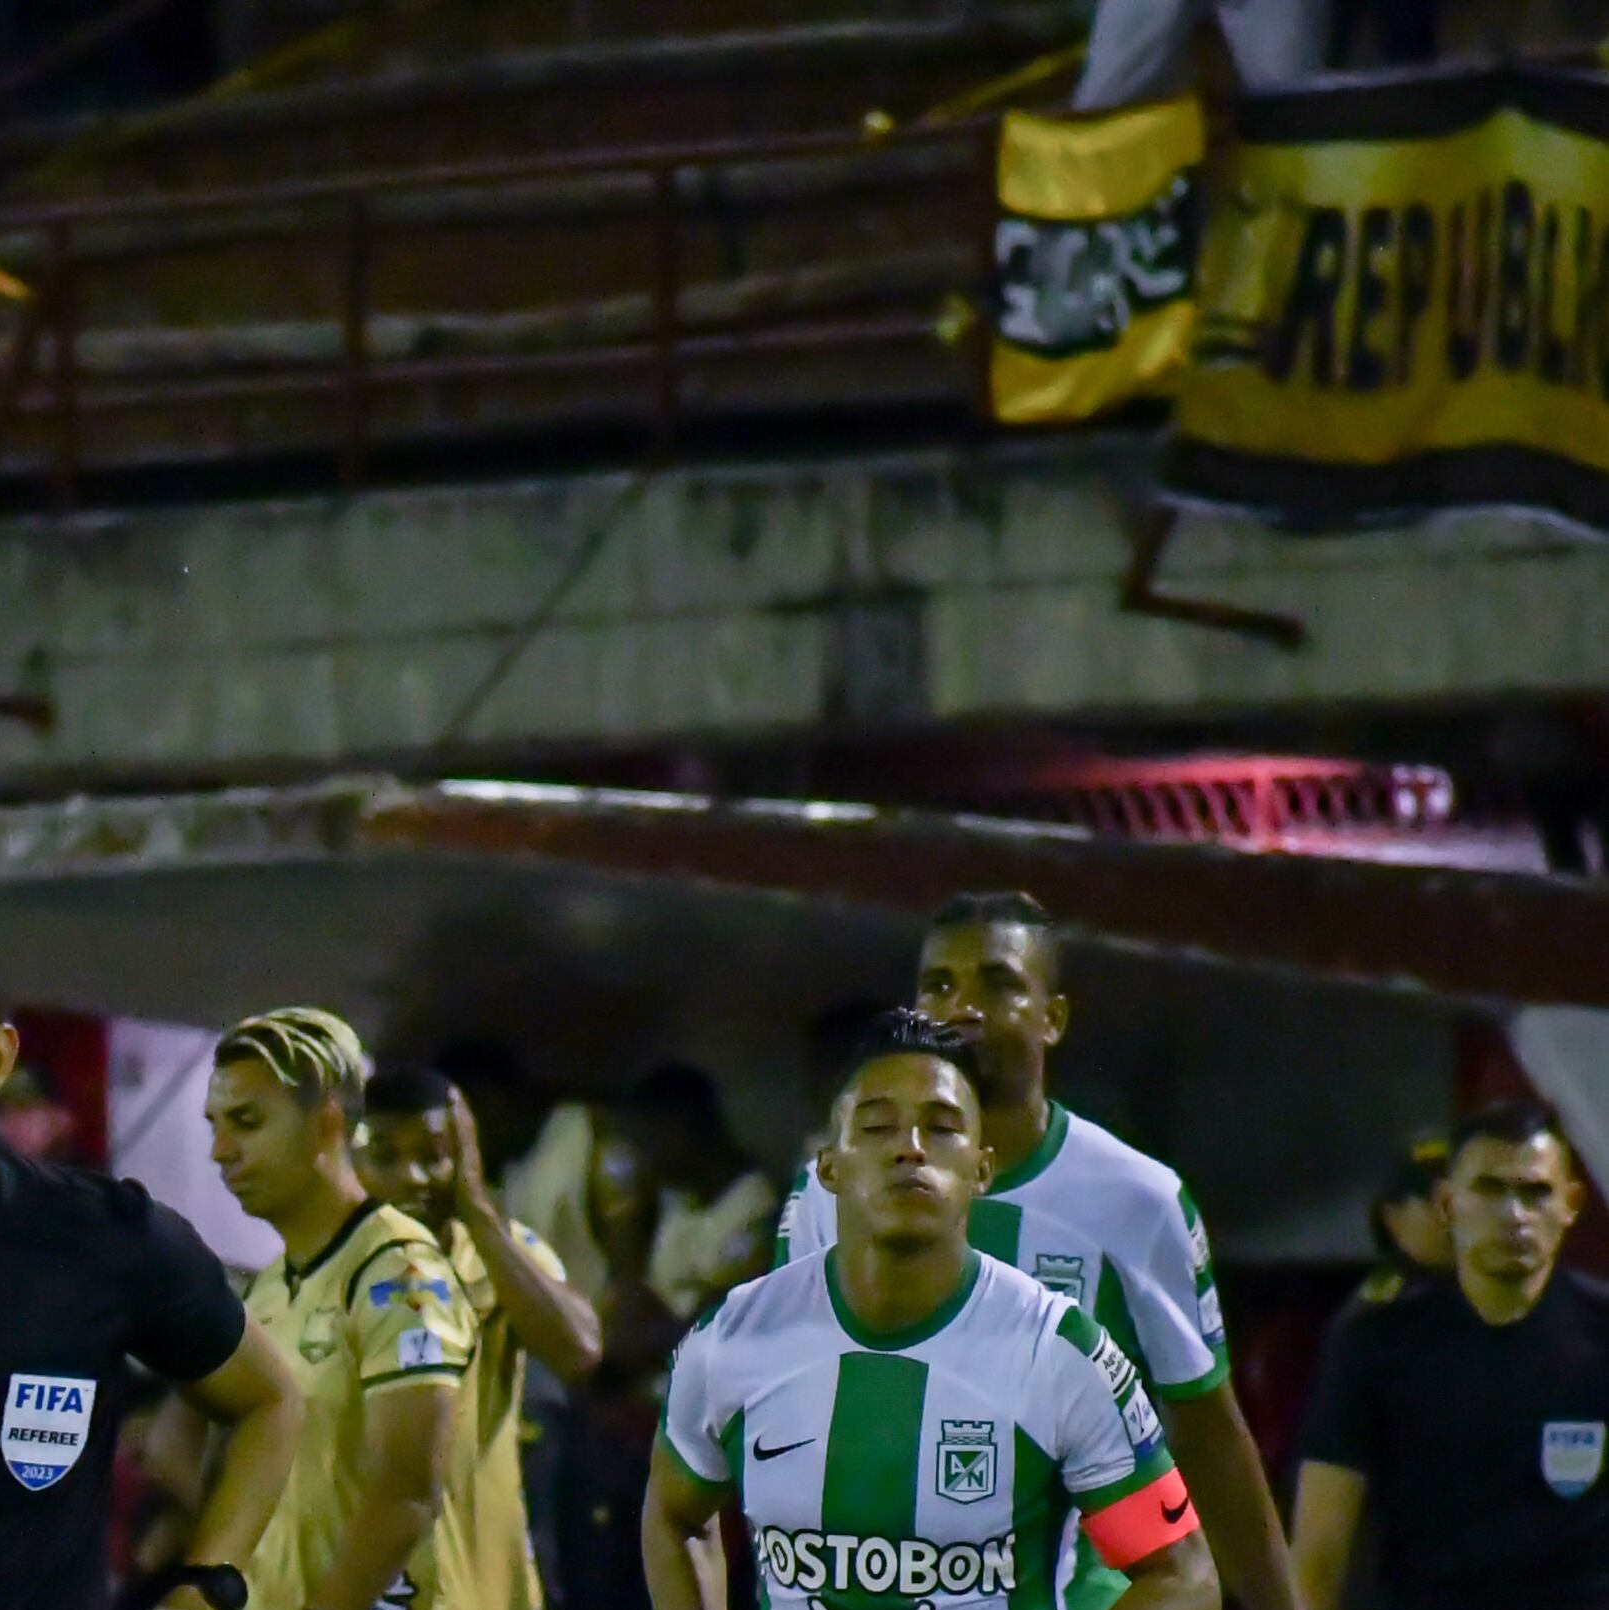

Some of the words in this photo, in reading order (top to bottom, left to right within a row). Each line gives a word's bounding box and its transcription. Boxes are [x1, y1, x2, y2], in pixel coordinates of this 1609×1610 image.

[1267, 180, 1609, 395] REPUBLI
[14, 1382, 83, 1414] FIFA
[8, 1427, 80, 1447] REFEREE
[21, 1464, 54, 1480] 2023
